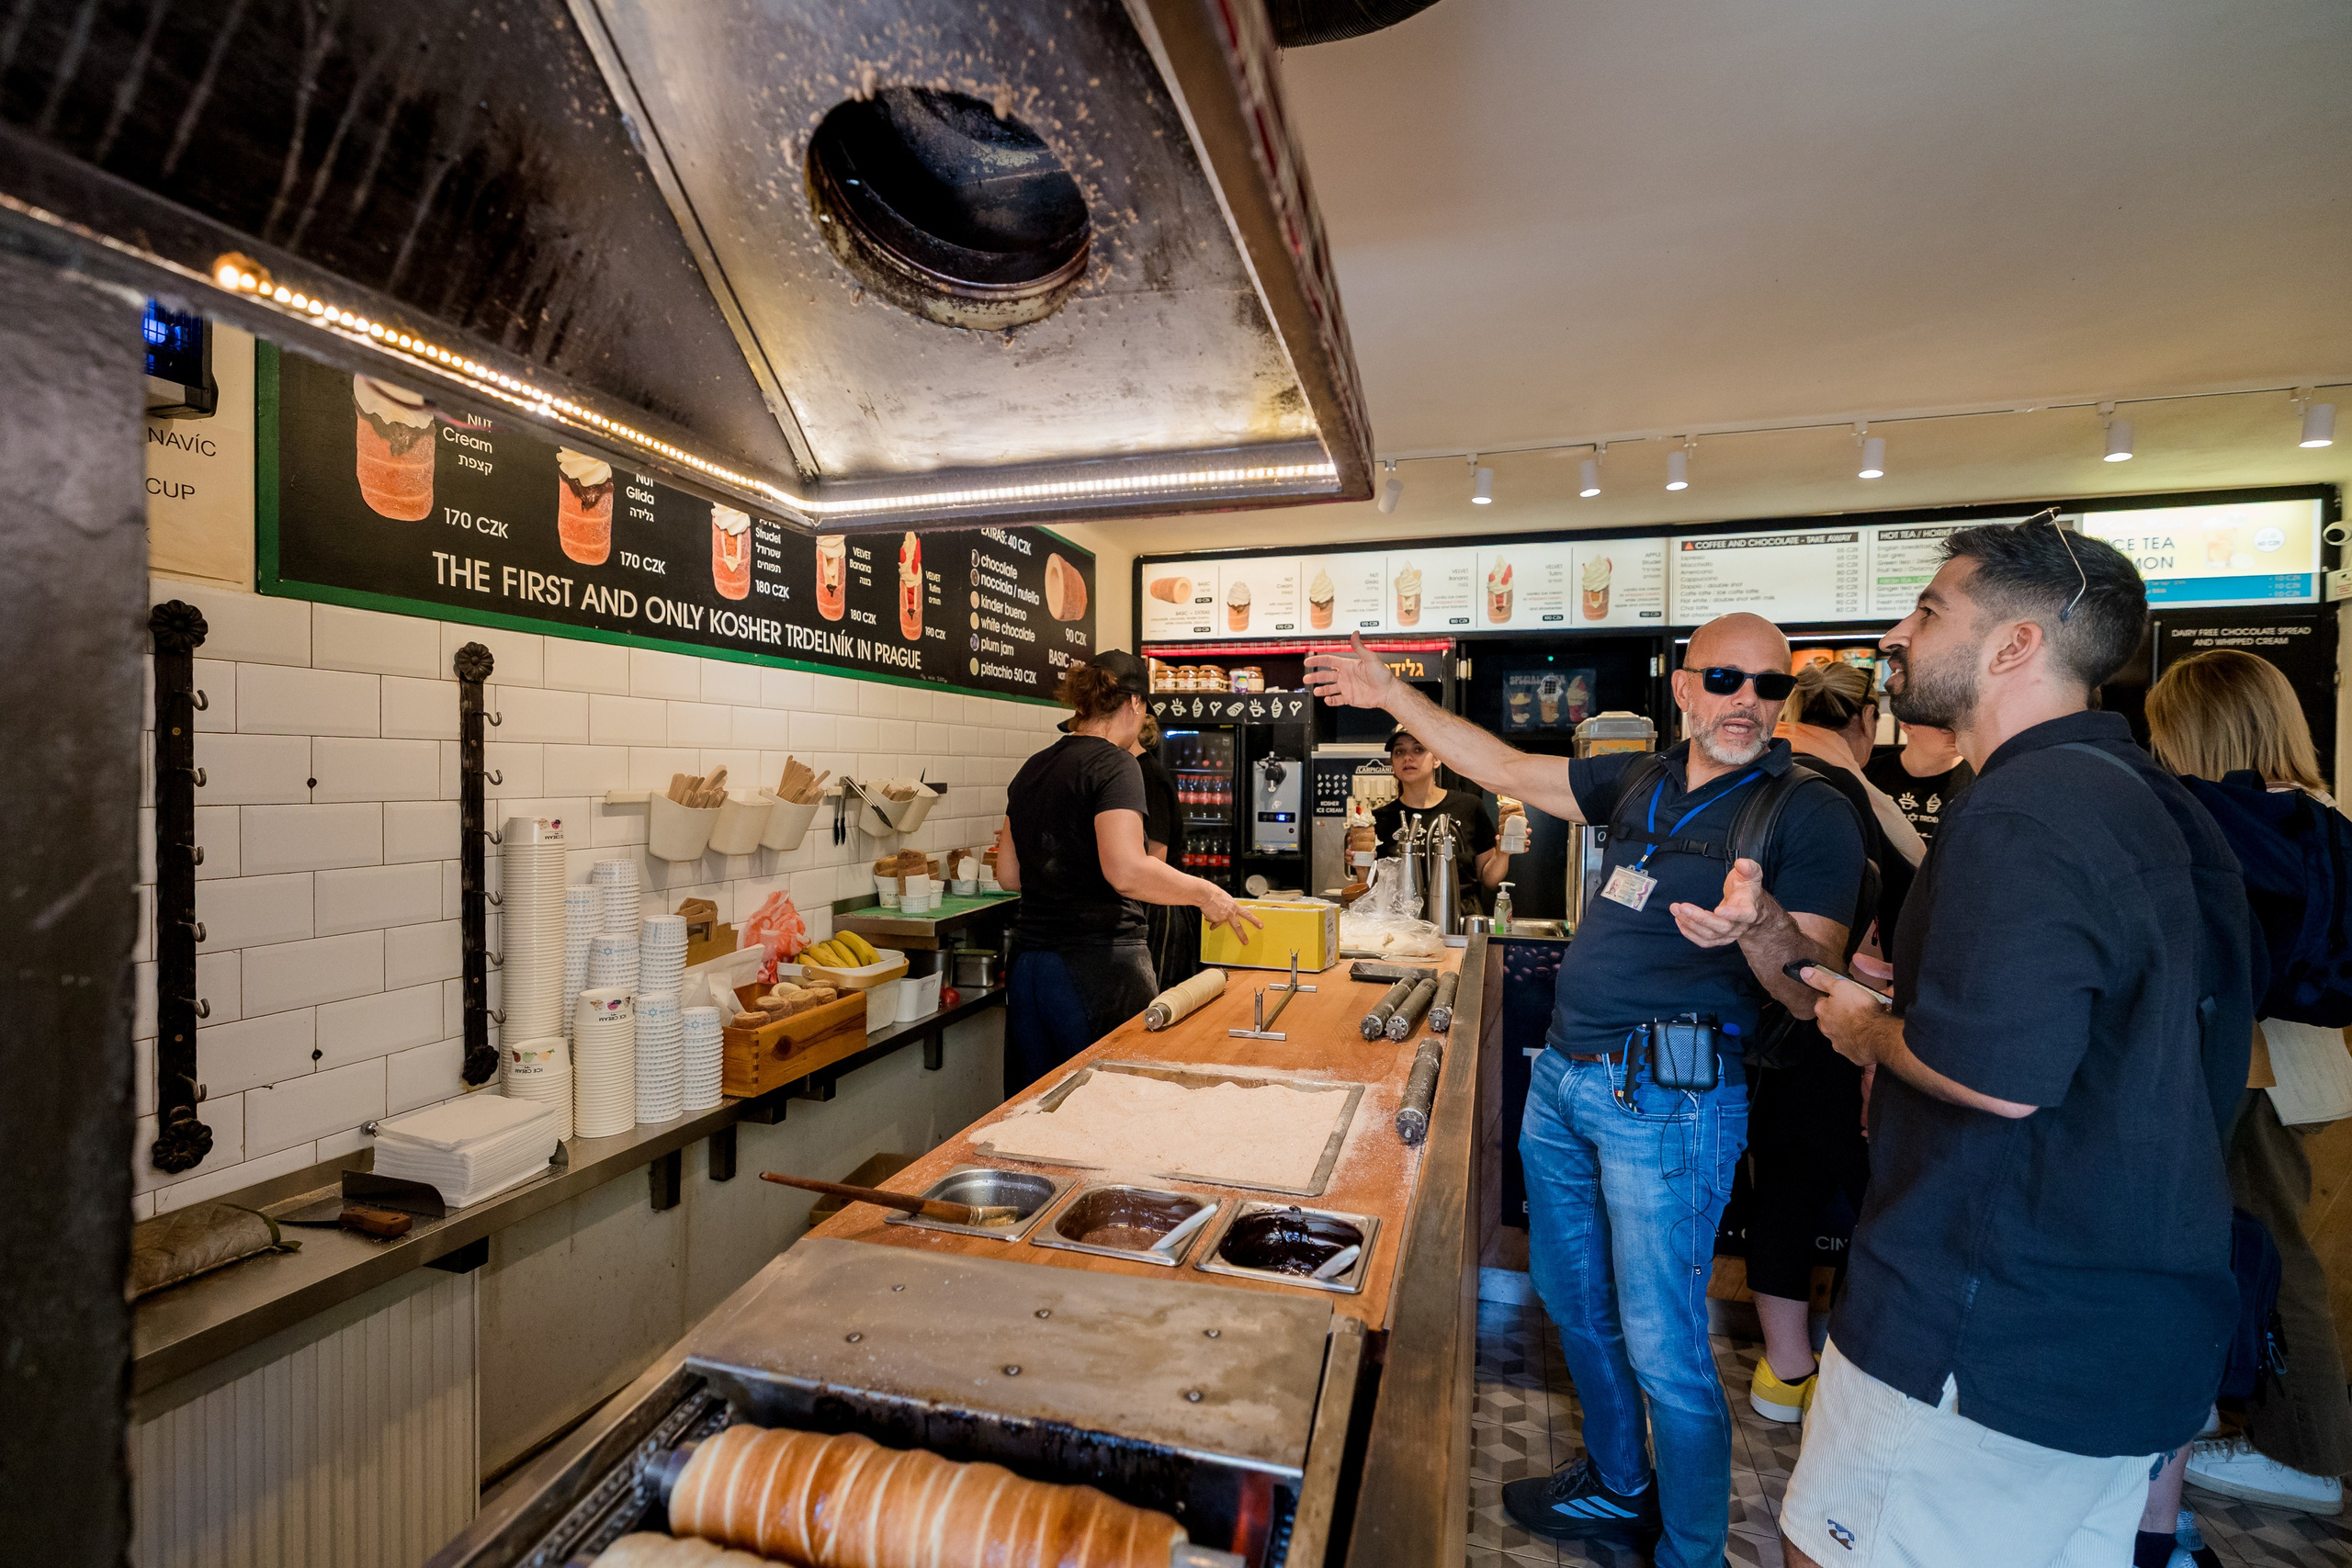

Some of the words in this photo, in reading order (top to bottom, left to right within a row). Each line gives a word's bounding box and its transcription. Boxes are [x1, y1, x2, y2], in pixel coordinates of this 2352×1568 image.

[467, 413, 492, 431] NUT
[147, 426, 217, 457] NAVÍC
[443, 426, 492, 454] Cream
[458, 454, 493, 476] קצפת
[145, 477, 196, 500] CUP
[626, 486, 655, 505] Glida
[444, 506, 472, 530] 170
[476, 516, 509, 539] CZK
[629, 506, 655, 523] גלידה
[755, 526, 781, 545] Strudel
[981, 527, 1008, 546] EXTRAS:
[1008, 534, 1017, 550] 40
[1017, 538, 1032, 556] CZK
[1694, 540, 1727, 549] COFFEE
[1727, 539, 1747, 547] AND
[1747, 536, 1800, 547] CHOCOLATE
[1806, 535, 1826, 544] TAKE
[1826, 534, 1852, 543] AWAY
[1880, 531, 1899, 540] HOT
[1900, 530, 1917, 539] TEA
[2111, 536, 2135, 551] CE
[2143, 536, 2176, 550] TEA
[620, 551, 640, 569] 170
[643, 557, 666, 575] CZK
[853, 546, 872, 561] VELVET
[2133, 556, 2175, 570] MON
[849, 558, 872, 574] Banana
[980, 554, 1019, 580] chocolate
[755, 580, 771, 595] 180
[772, 584, 790, 600] CZK
[980, 573, 1013, 595] nocciola
[1017, 587, 1040, 606] nutella
[432, 551, 491, 593] THE
[503, 565, 574, 608] FIRST
[580, 583, 639, 618] AND
[644, 595, 705, 631] ONLY
[708, 607, 782, 646] KOSHER
[785, 622, 854, 660] TRDELNÍK
[856, 638, 872, 661] IN
[875, 642, 922, 671] PRAGUE
[850, 608, 862, 622] 180
[862, 612, 876, 626] CZK
[980, 594, 1004, 613] kinder
[1004, 601, 1027, 622] bueno
[924, 626, 934, 637] 190
[934, 628, 946, 640] CZK
[980, 616, 1001, 634] white
[1001, 622, 1036, 643] chocolate
[1065, 627, 1074, 643] 90
[1074, 630, 1088, 647] CZK
[2171, 628, 2197, 637] DAIRY
[2198, 627, 2220, 637] FREE
[2220, 626, 2277, 637] CHOCOLATE
[2277, 626, 2312, 636] SPREAD
[980, 637, 1001, 654] plum
[1000, 640, 1014, 657] jam
[2192, 637, 2214, 647] AND
[2214, 637, 2254, 647] WHIPPED
[2255, 637, 2290, 646] CREAM
[1048, 649, 1069, 669] BASIC
[1384, 658, 1425, 677] גליד
[980, 661, 1012, 681] pistachio
[1013, 669, 1023, 682] 50
[1023, 671, 1037, 685] CZK
